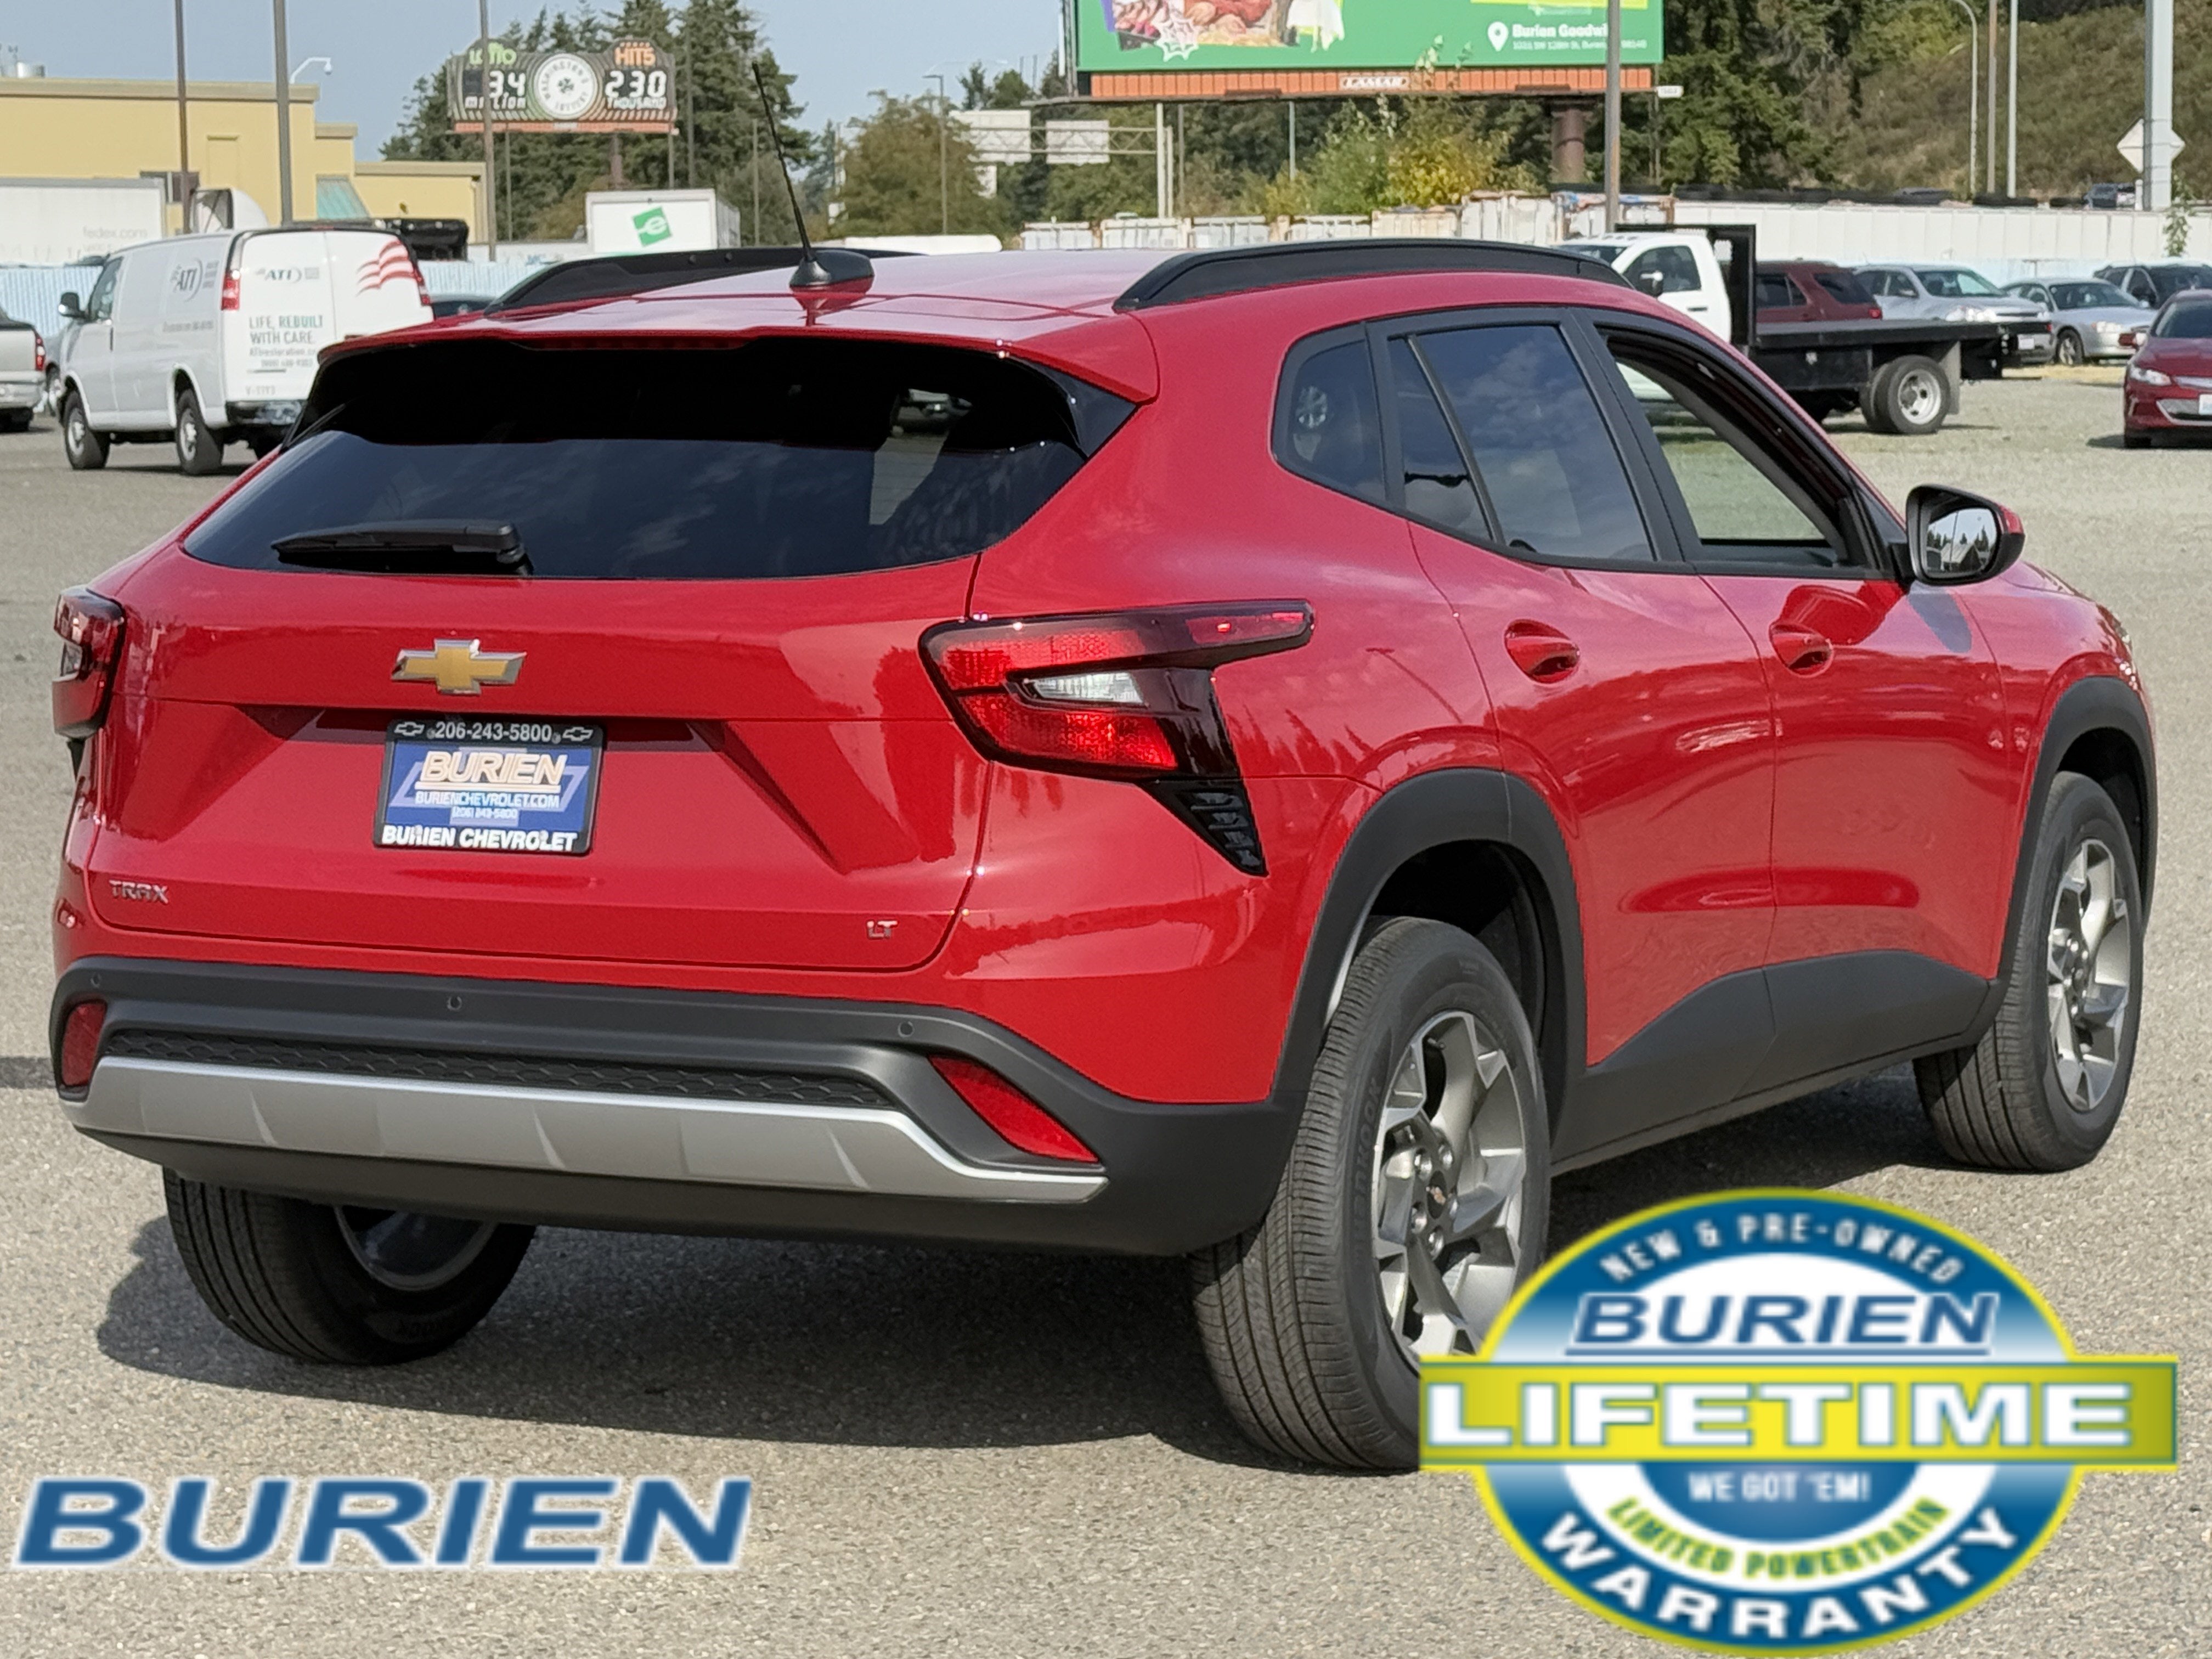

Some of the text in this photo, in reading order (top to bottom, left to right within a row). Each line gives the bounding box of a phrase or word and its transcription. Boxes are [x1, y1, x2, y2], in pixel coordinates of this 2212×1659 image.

[1513, 24, 1556, 37] Burien
[605, 70, 667, 98] 230
[264, 269, 292, 281] ATI
[279, 315, 323, 328] REBUILT
[250, 331, 280, 344] WITH
[435, 721, 552, 741] 206-243-5800
[420, 750, 568, 785] BURIEN
[414, 791, 560, 809] BURIENCHEVROLET.COM
[382, 824, 577, 851] BURIEN CHEVROLET
[109, 879, 169, 904] TRAX
[867, 920, 898, 938] LT
